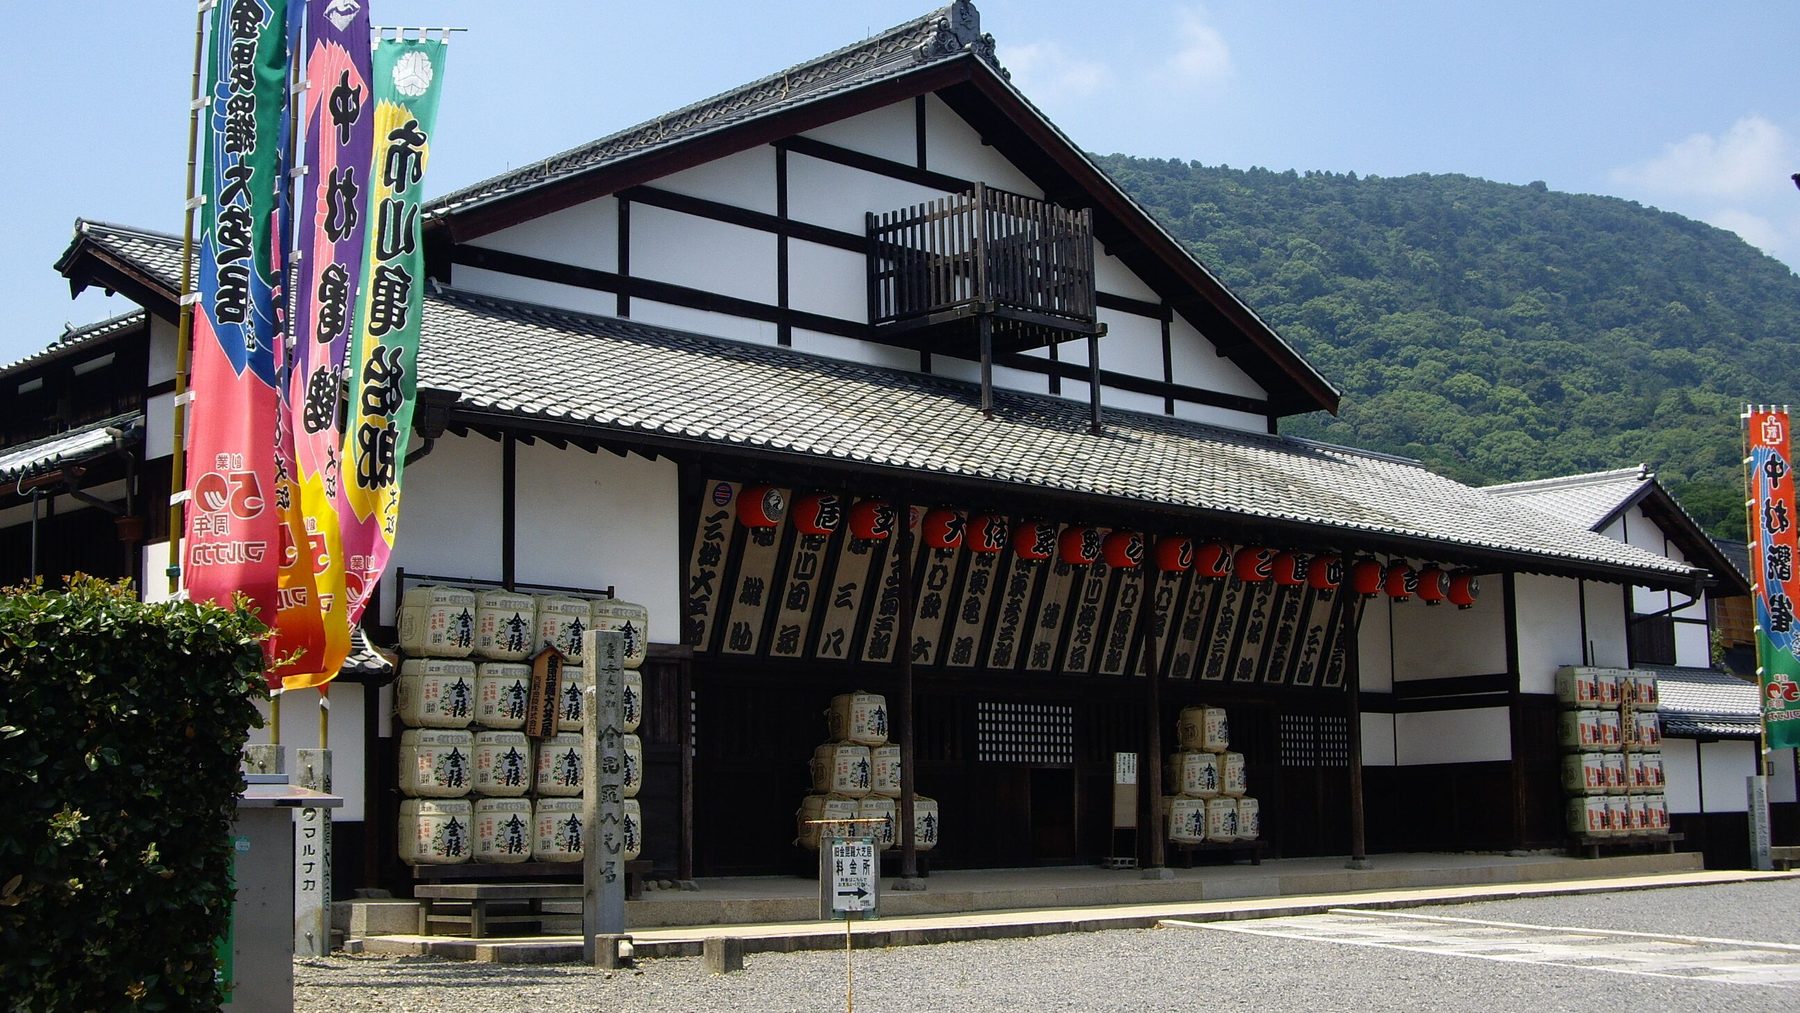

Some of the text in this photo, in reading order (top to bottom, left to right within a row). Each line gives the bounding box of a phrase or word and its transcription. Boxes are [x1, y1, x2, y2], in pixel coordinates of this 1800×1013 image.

[457, 607, 474, 649] 金陵
[506, 612, 527, 653] 金陵
[450, 676, 470, 718] 金陵
[509, 679, 527, 719] 金陵
[565, 681, 584, 721] 金陵
[446, 746, 466, 788] 金陵
[503, 746, 523, 787] 金陵
[563, 747, 582, 787] 金陵
[443, 815, 464, 857] 金陵
[505, 813, 525, 854] 金陵
[564, 813, 584, 854] 金陵
[302, 827, 317, 892] マルナカ
[836, 858, 871, 876] 料金所
